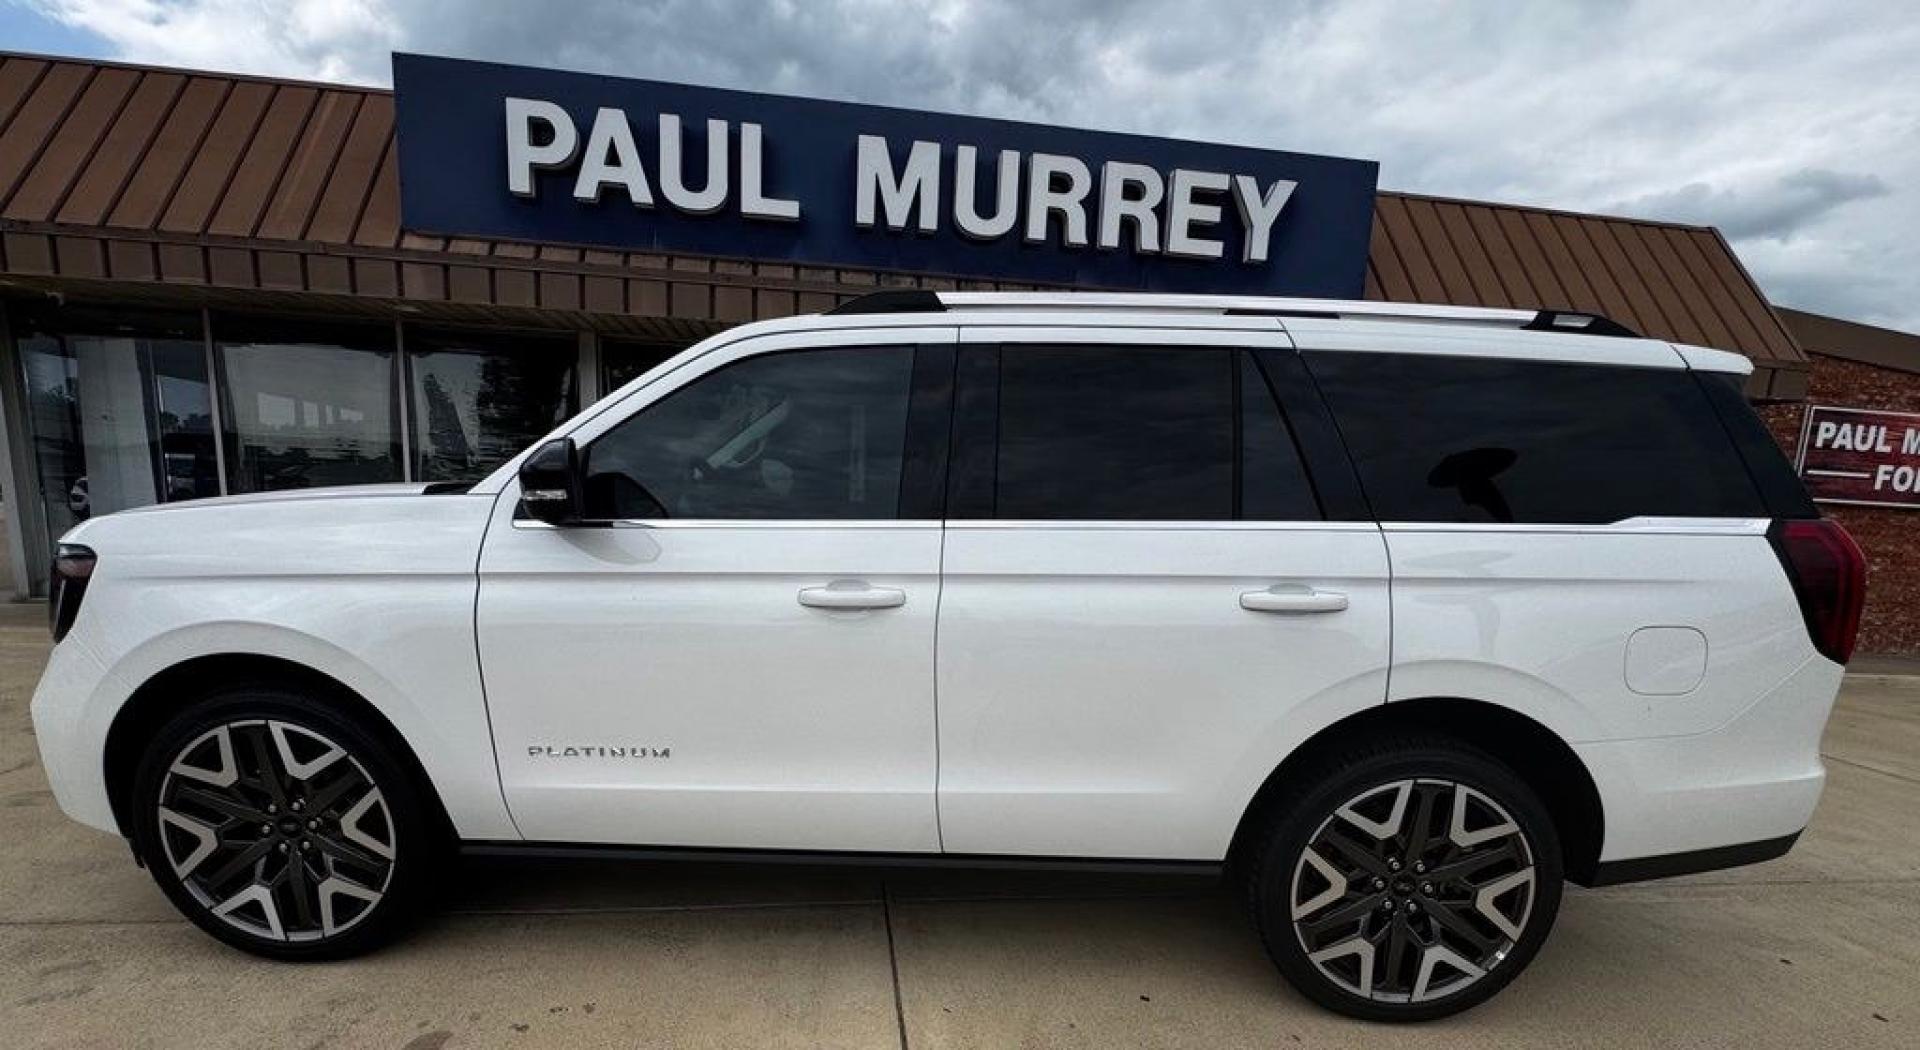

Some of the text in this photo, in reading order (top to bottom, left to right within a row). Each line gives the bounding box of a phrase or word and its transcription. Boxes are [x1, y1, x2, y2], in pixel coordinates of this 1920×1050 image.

[505, 96, 1297, 263] PAUL MURREY
[1815, 421, 1892, 453] PAUL
[528, 746, 671, 758] PLATINUM
